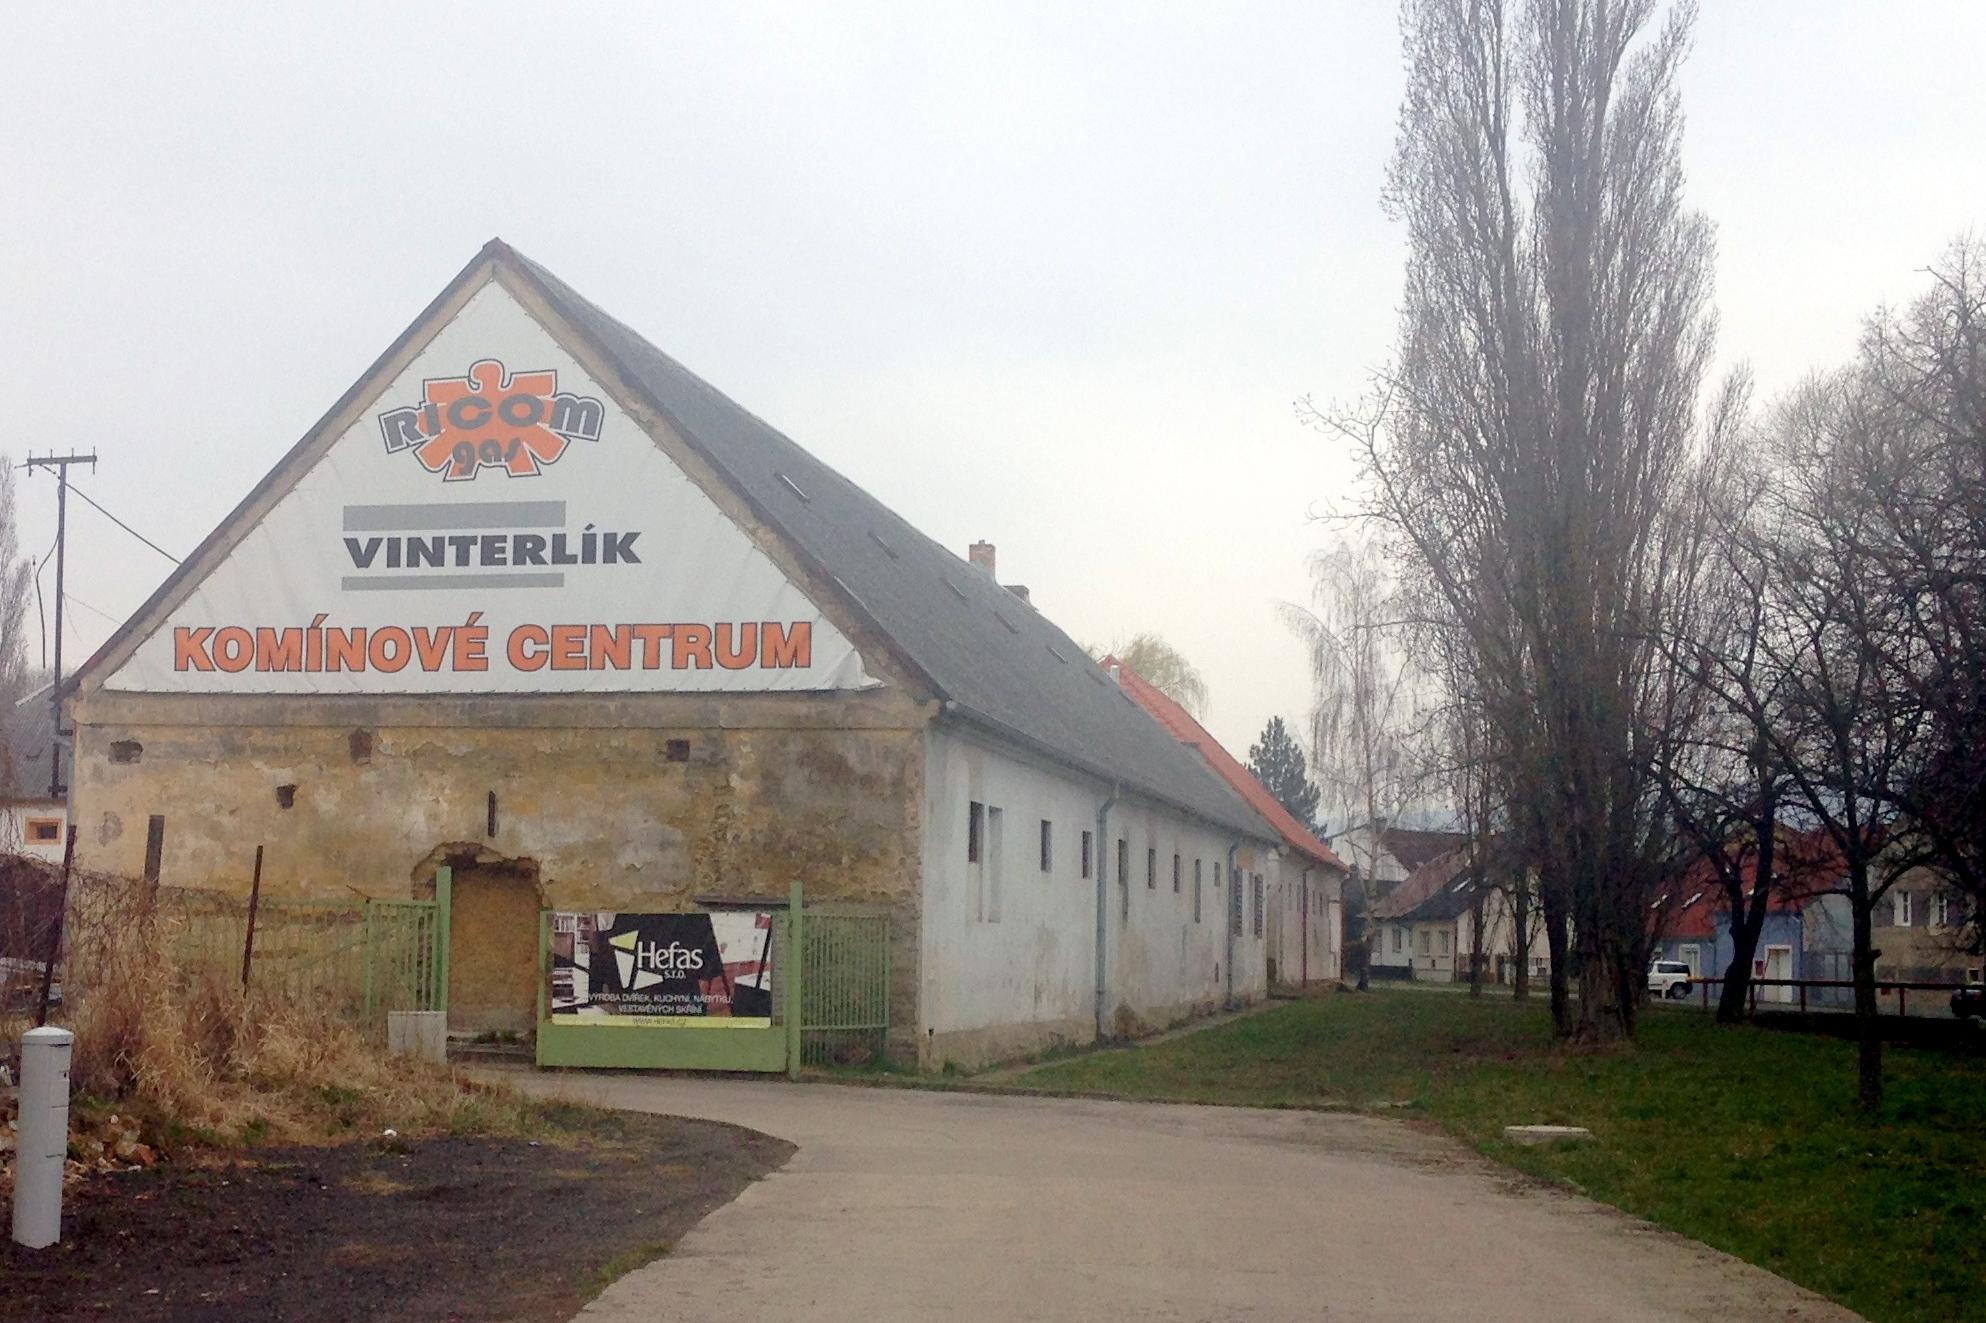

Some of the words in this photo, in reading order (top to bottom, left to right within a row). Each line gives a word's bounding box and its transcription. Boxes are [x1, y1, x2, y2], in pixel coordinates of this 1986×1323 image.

[452, 437, 522, 477] gas
[343, 523, 642, 568] VINTERLÍK
[173, 611, 489, 673] KOMÍNOVÉ
[506, 621, 812, 672] CENTRUM
[637, 941, 704, 969] Hefas
